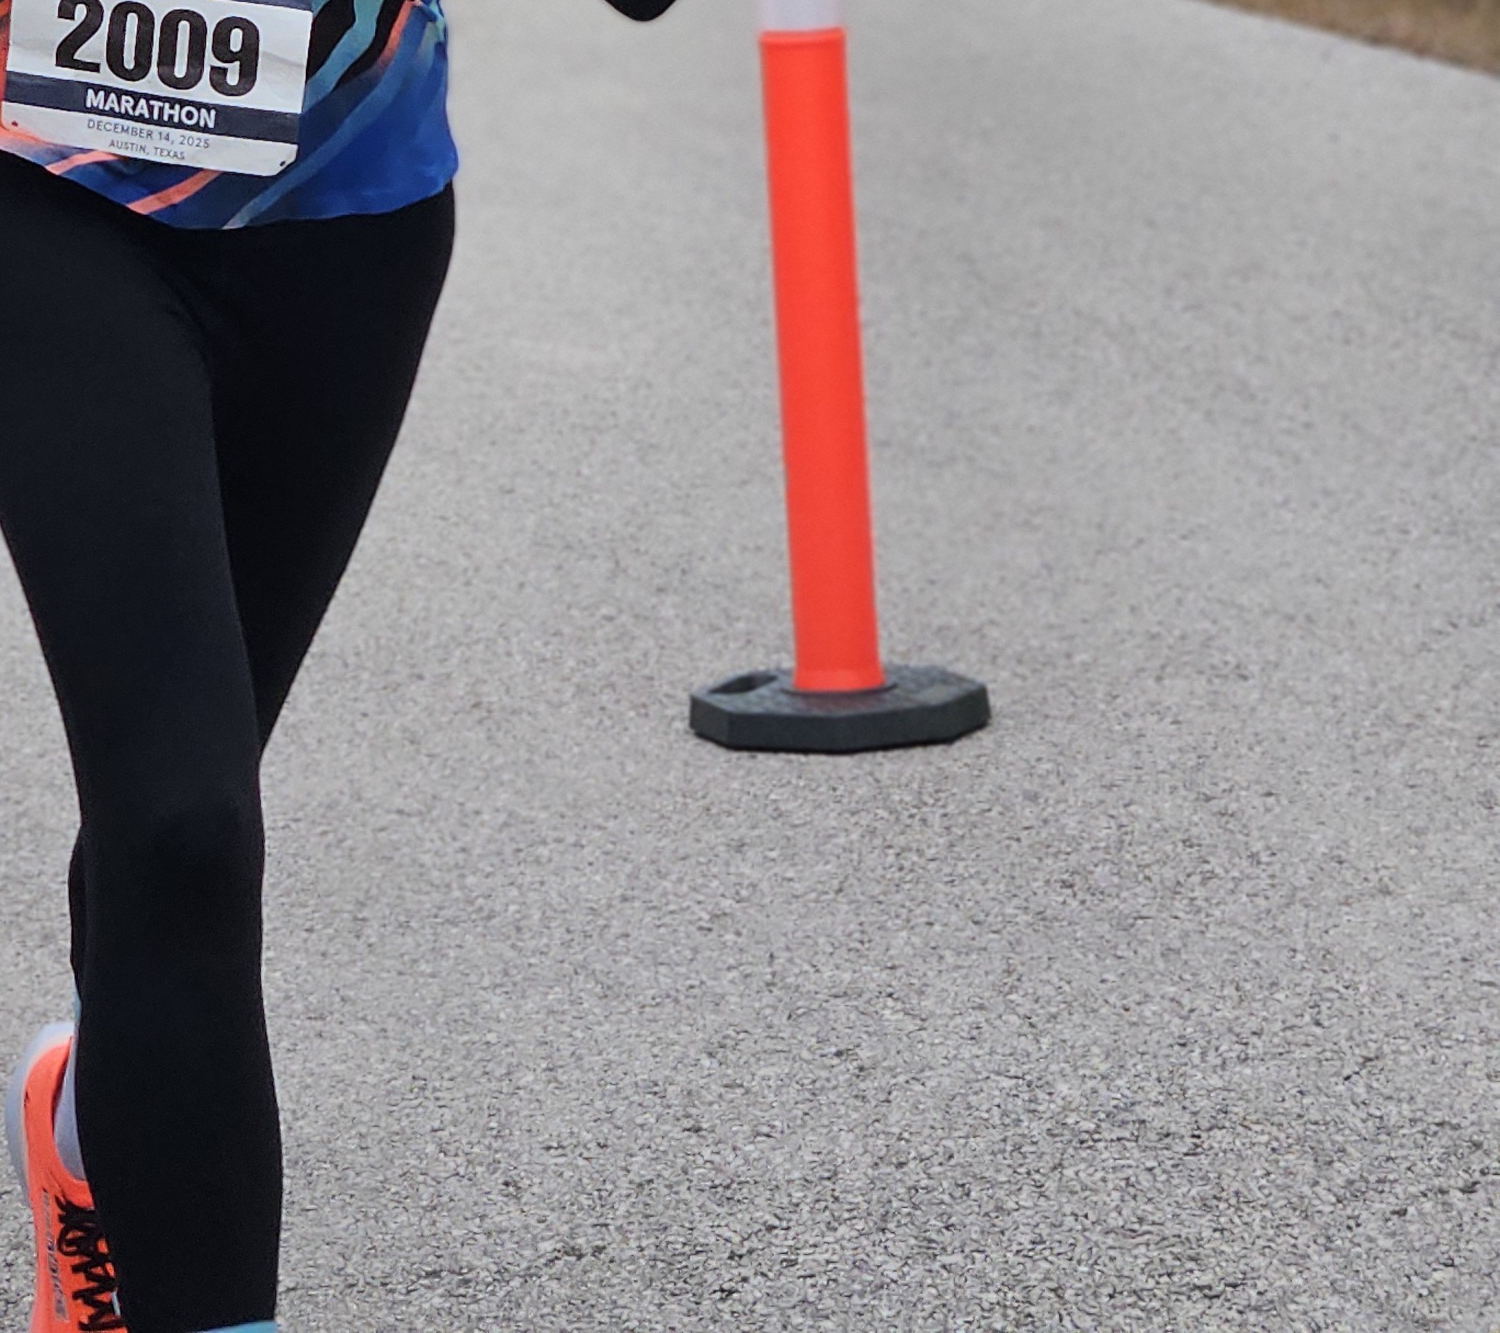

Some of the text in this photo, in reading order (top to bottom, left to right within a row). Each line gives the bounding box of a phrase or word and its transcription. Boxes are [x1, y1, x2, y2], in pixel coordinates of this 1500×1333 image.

[85, 88, 216, 129] MARATHON
[87, 119, 153, 140] DECEMBER
[157, 131, 174, 145] 14,
[109, 139, 185, 160] AUSTIN, TEXAS
